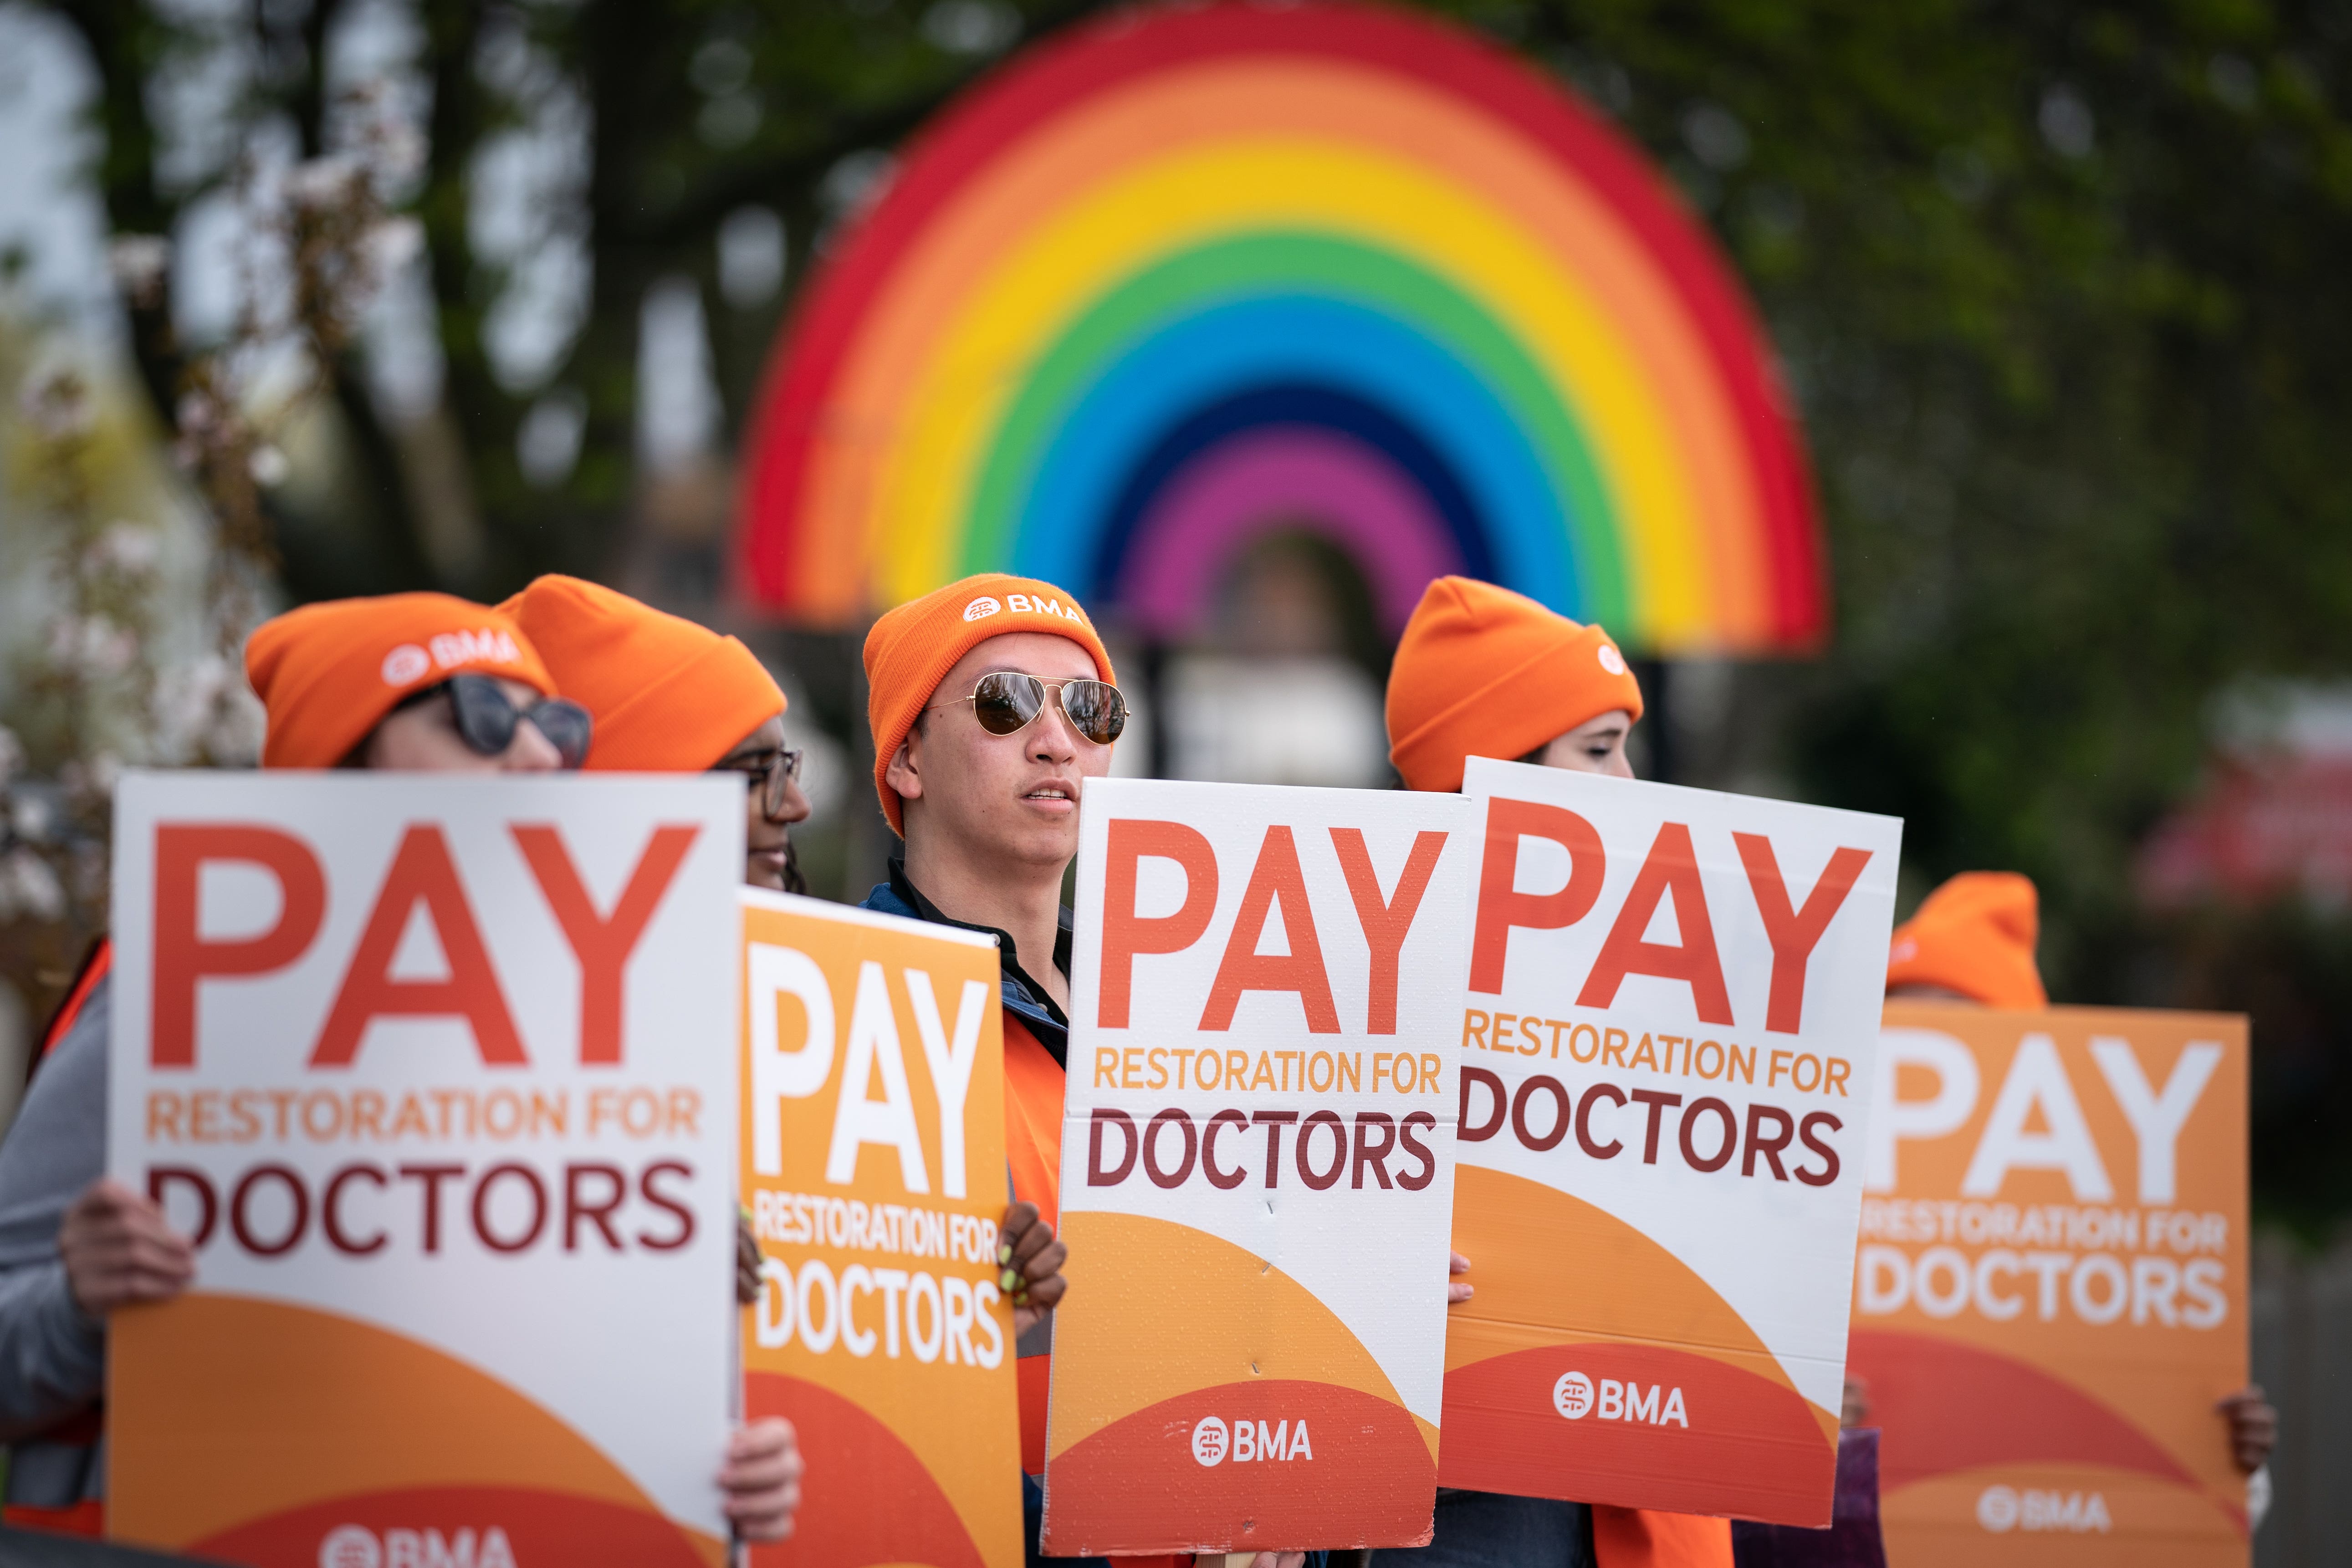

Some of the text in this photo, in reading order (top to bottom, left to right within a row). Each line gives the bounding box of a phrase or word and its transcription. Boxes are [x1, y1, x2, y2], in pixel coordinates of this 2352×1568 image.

[1007, 594, 1084, 625] BMA
[150, 820, 703, 1071] PAY
[1098, 818, 1450, 1035] PAY
[1468, 796, 1874, 1035] PAY
[749, 941, 989, 1199] PAY
[1094, 1047, 1441, 1094] RESTORATION FOR
[1462, 1009, 1851, 1097] RESTORATION FOR
[146, 1088, 701, 1143] RESTORATION FOR
[1087, 1107, 1437, 1191] DOCTORS
[1457, 1066, 1844, 1186] DOCTORS
[1864, 1026, 2225, 1206] PAY
[146, 1161, 696, 1261] DOCTORS
[754, 1189, 999, 1266] RESTORATION FOR
[1859, 1199, 2228, 1253] RESTORATION FOR
[756, 1256, 1003, 1370] DOCTORS
[1857, 1244, 2228, 1330] DOCTORS
[1233, 1420, 1313, 1462] BMA
[1598, 1379, 1689, 1428] BMA
